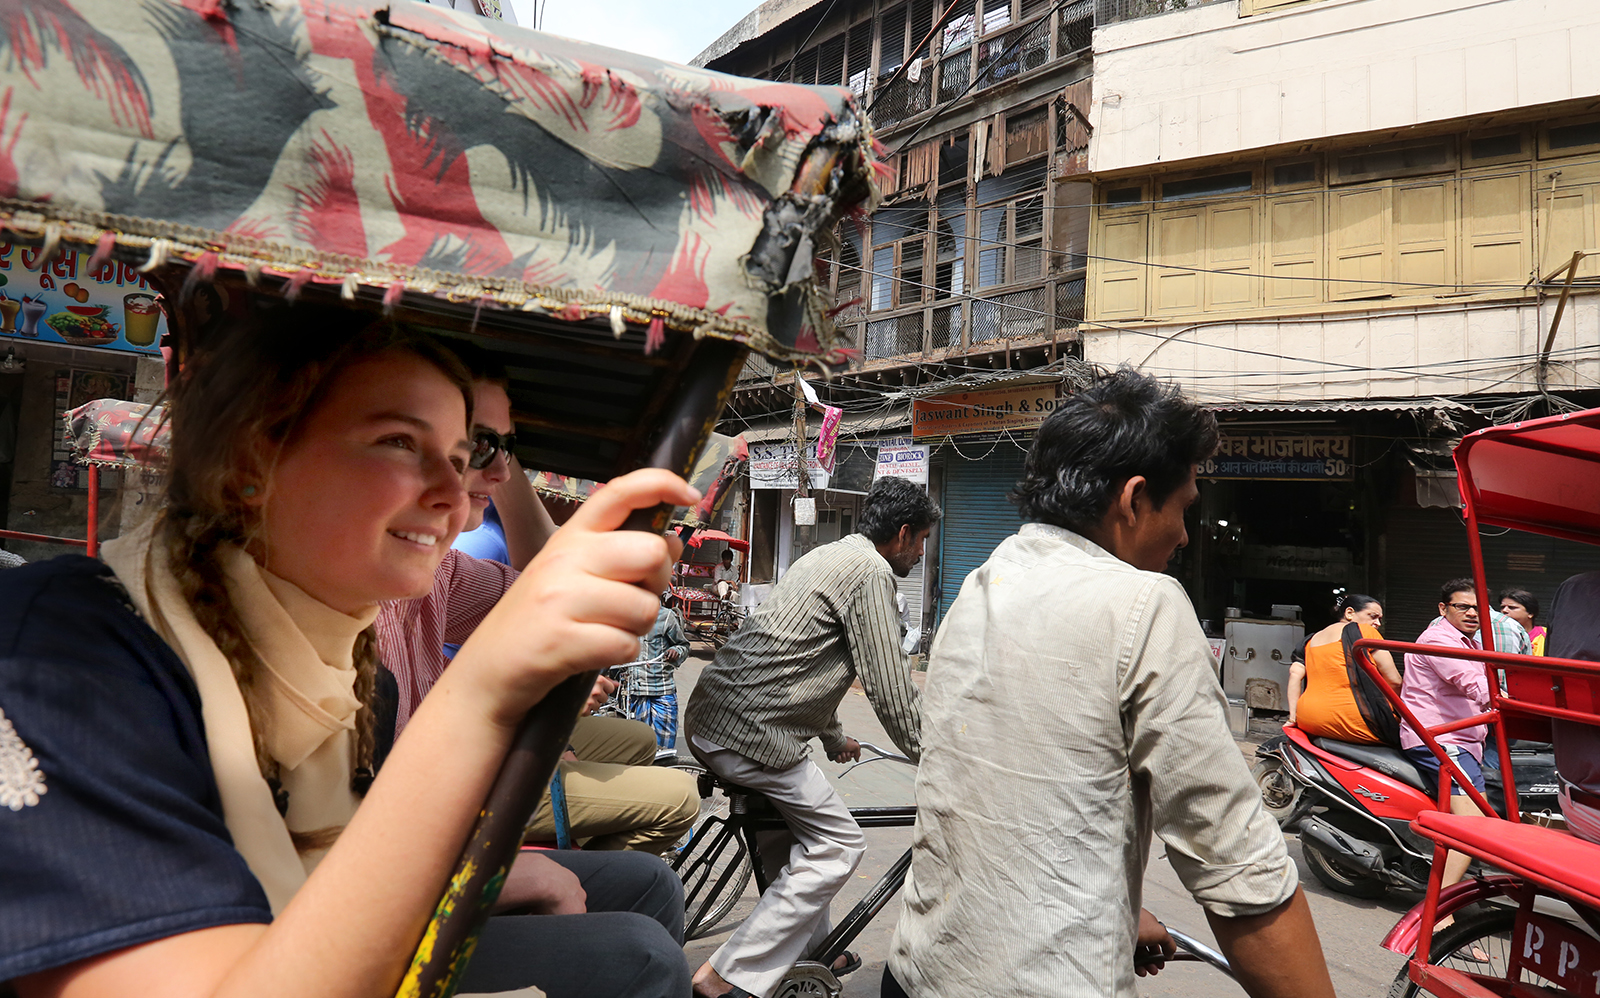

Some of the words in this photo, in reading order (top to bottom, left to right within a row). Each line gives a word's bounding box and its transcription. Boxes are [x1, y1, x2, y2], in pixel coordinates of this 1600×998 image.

[914, 407, 969, 425] Jaswant
[972, 401, 1013, 419] Singh
[1018, 399, 1030, 412] &
[892, 467, 924, 475] DENTSPLY
